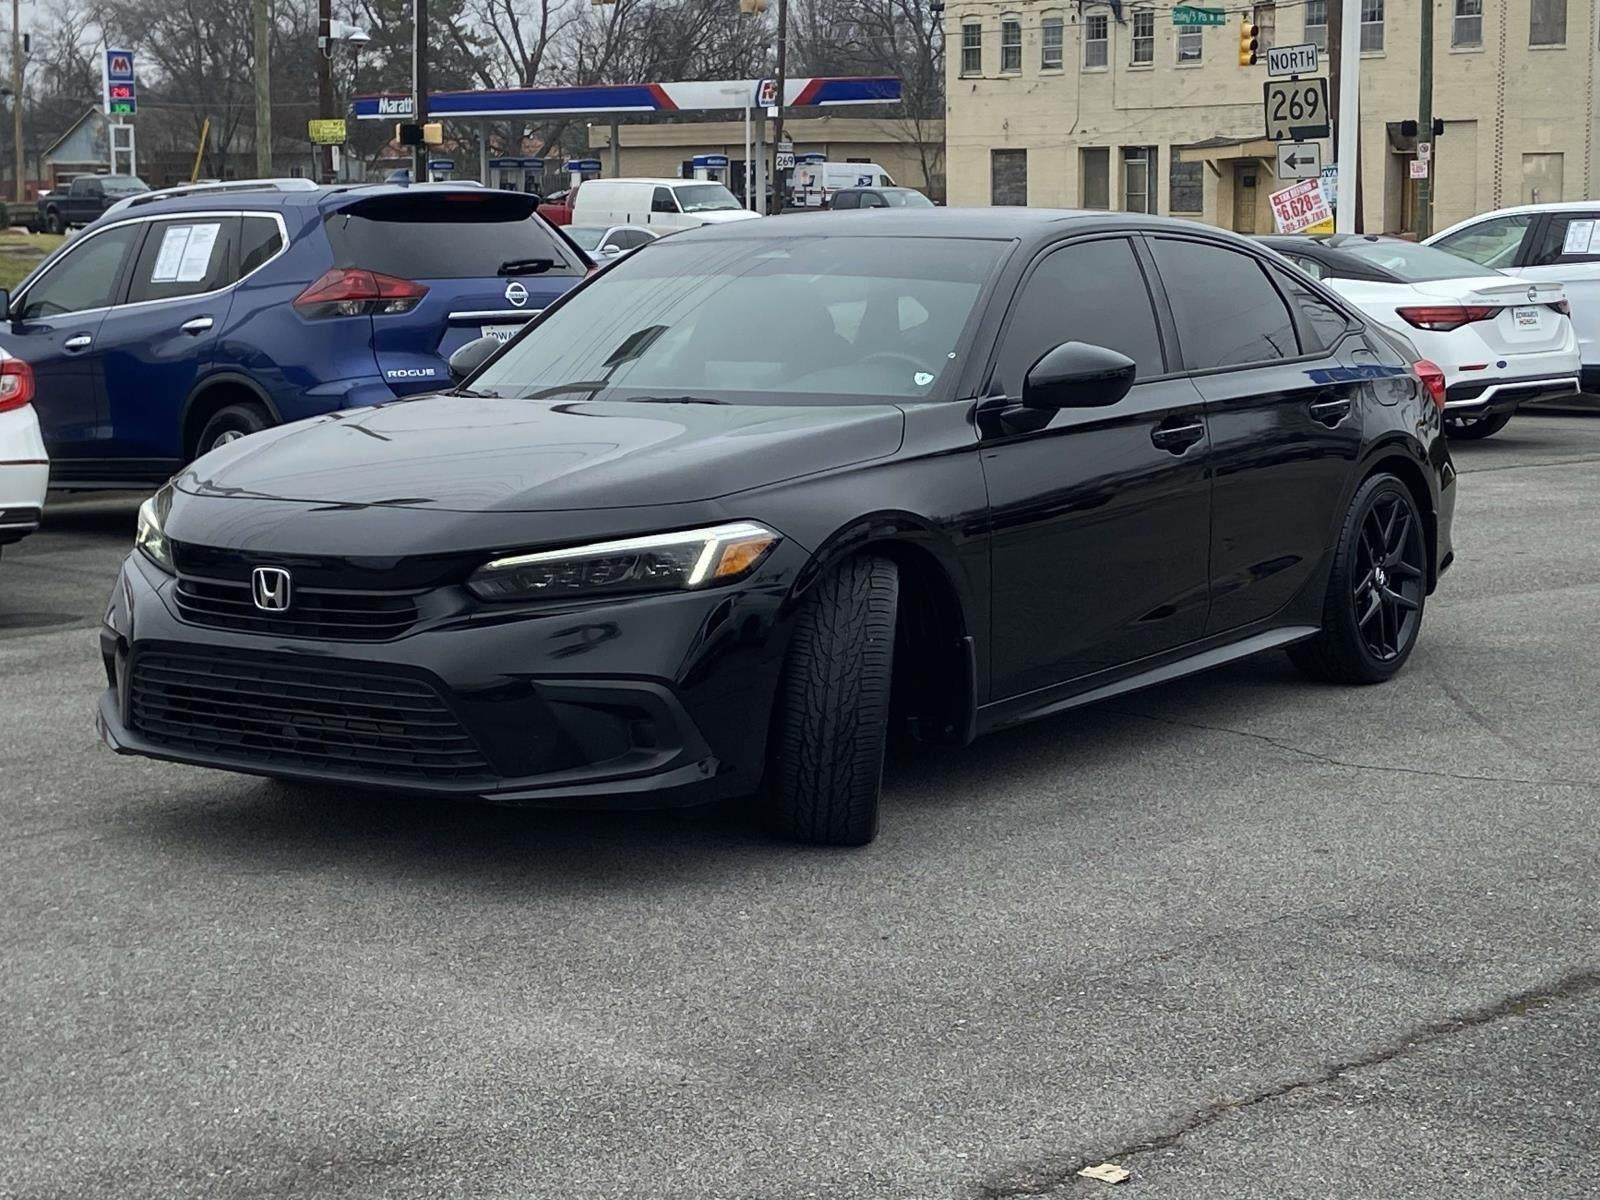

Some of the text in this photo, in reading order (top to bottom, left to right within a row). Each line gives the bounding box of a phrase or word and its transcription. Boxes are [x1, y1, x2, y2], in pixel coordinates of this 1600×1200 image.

[1270, 50, 1315, 71] NORTH
[1272, 87, 1319, 121] 269
[777, 156, 793, 167] 269
[1321, 168, 1338, 178] HVA
[1276, 194, 1313, 221] $6,628
[387, 368, 435, 378] ROGUE
